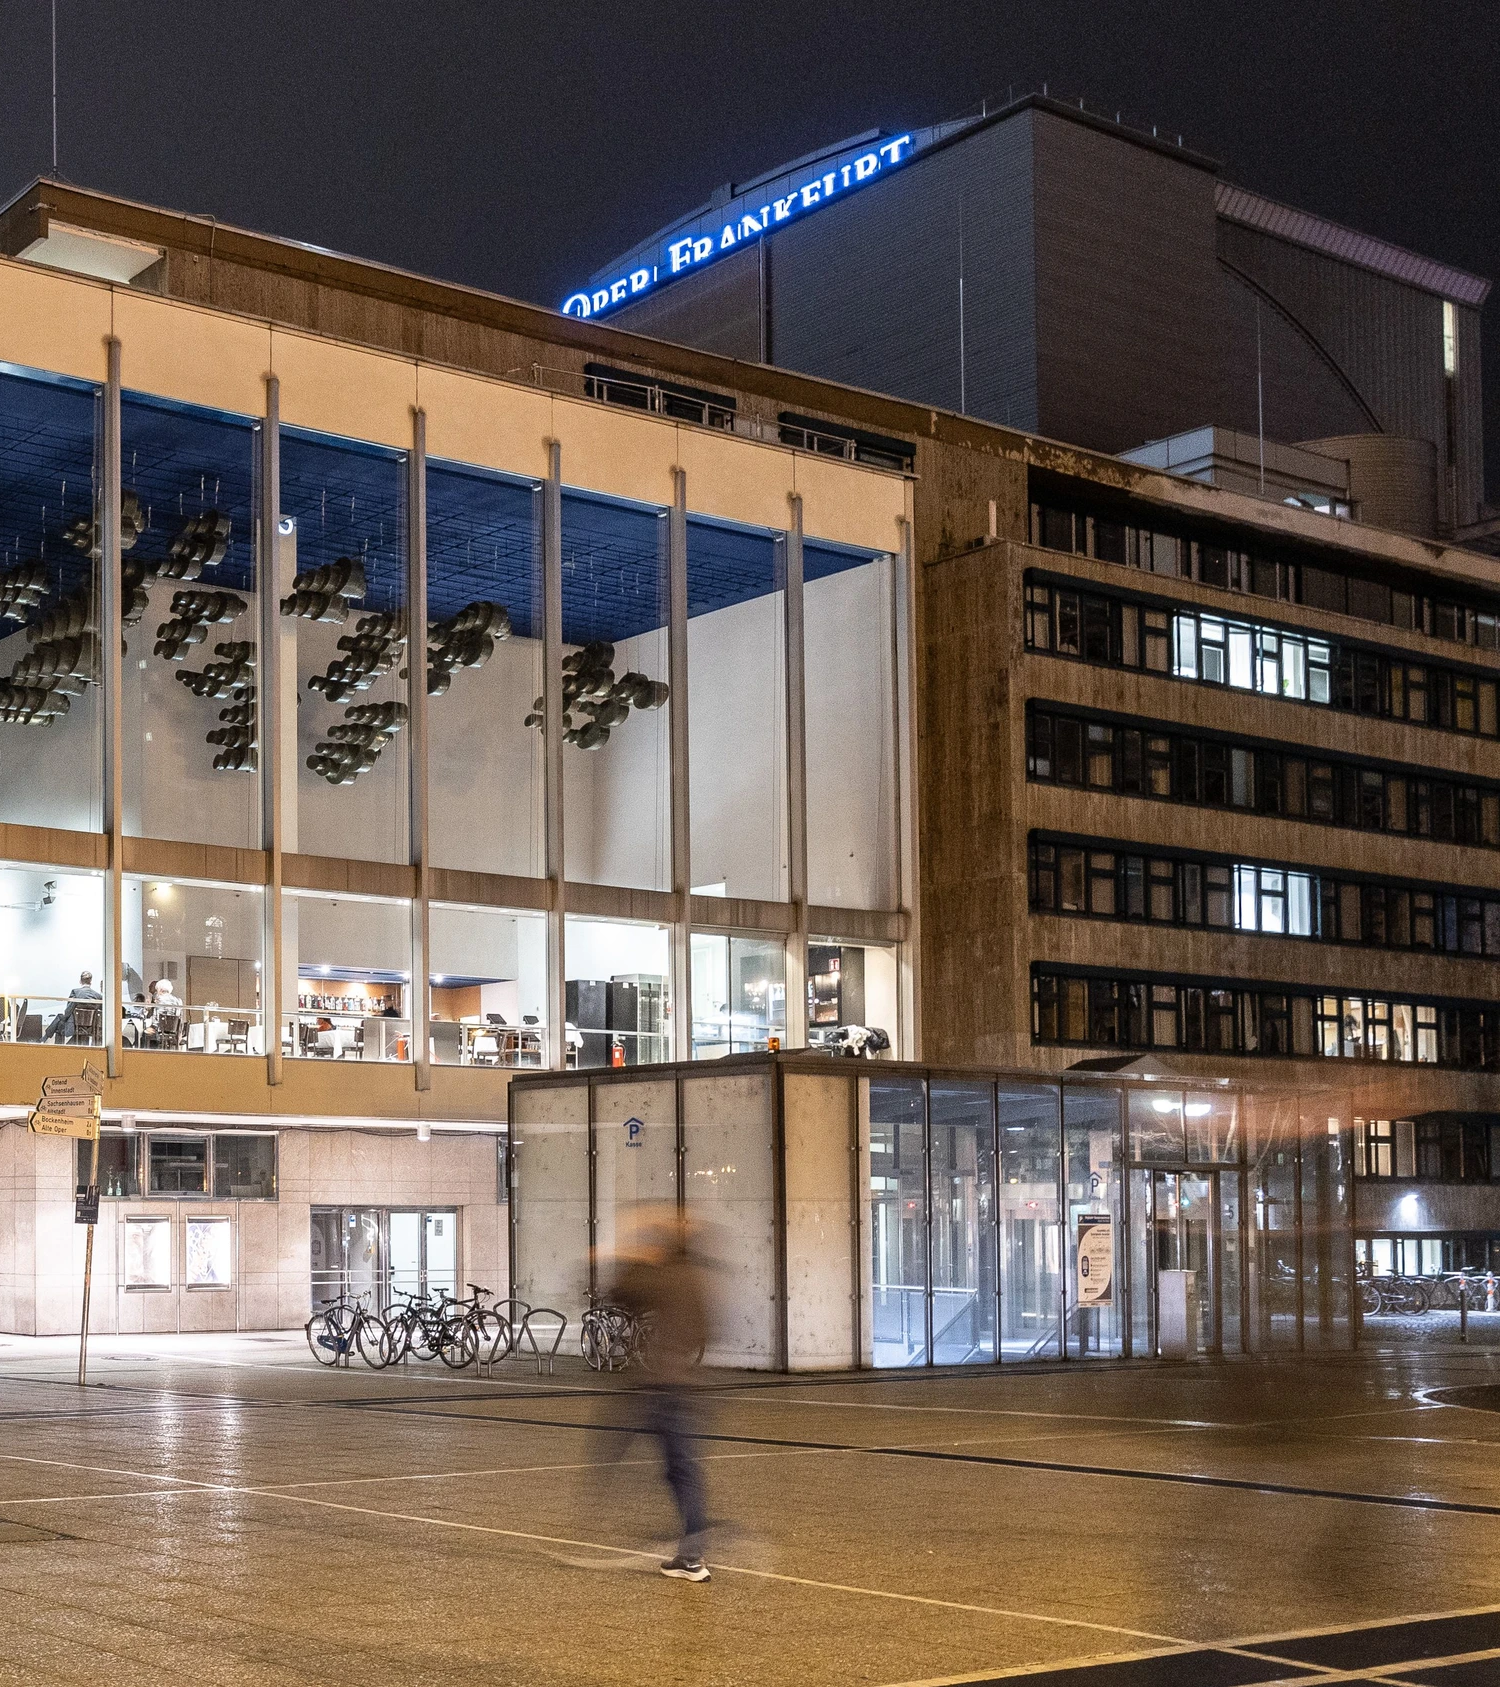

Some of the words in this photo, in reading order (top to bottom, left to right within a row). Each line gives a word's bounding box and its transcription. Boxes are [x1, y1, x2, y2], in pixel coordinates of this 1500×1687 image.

[562, 268, 658, 318] OPER
[668, 134, 910, 273] FRANKFURT
[41, 1115, 74, 1125] Bockenheim
[41, 1124, 52, 1132] Alte
[54, 1125, 67, 1133] Oper
